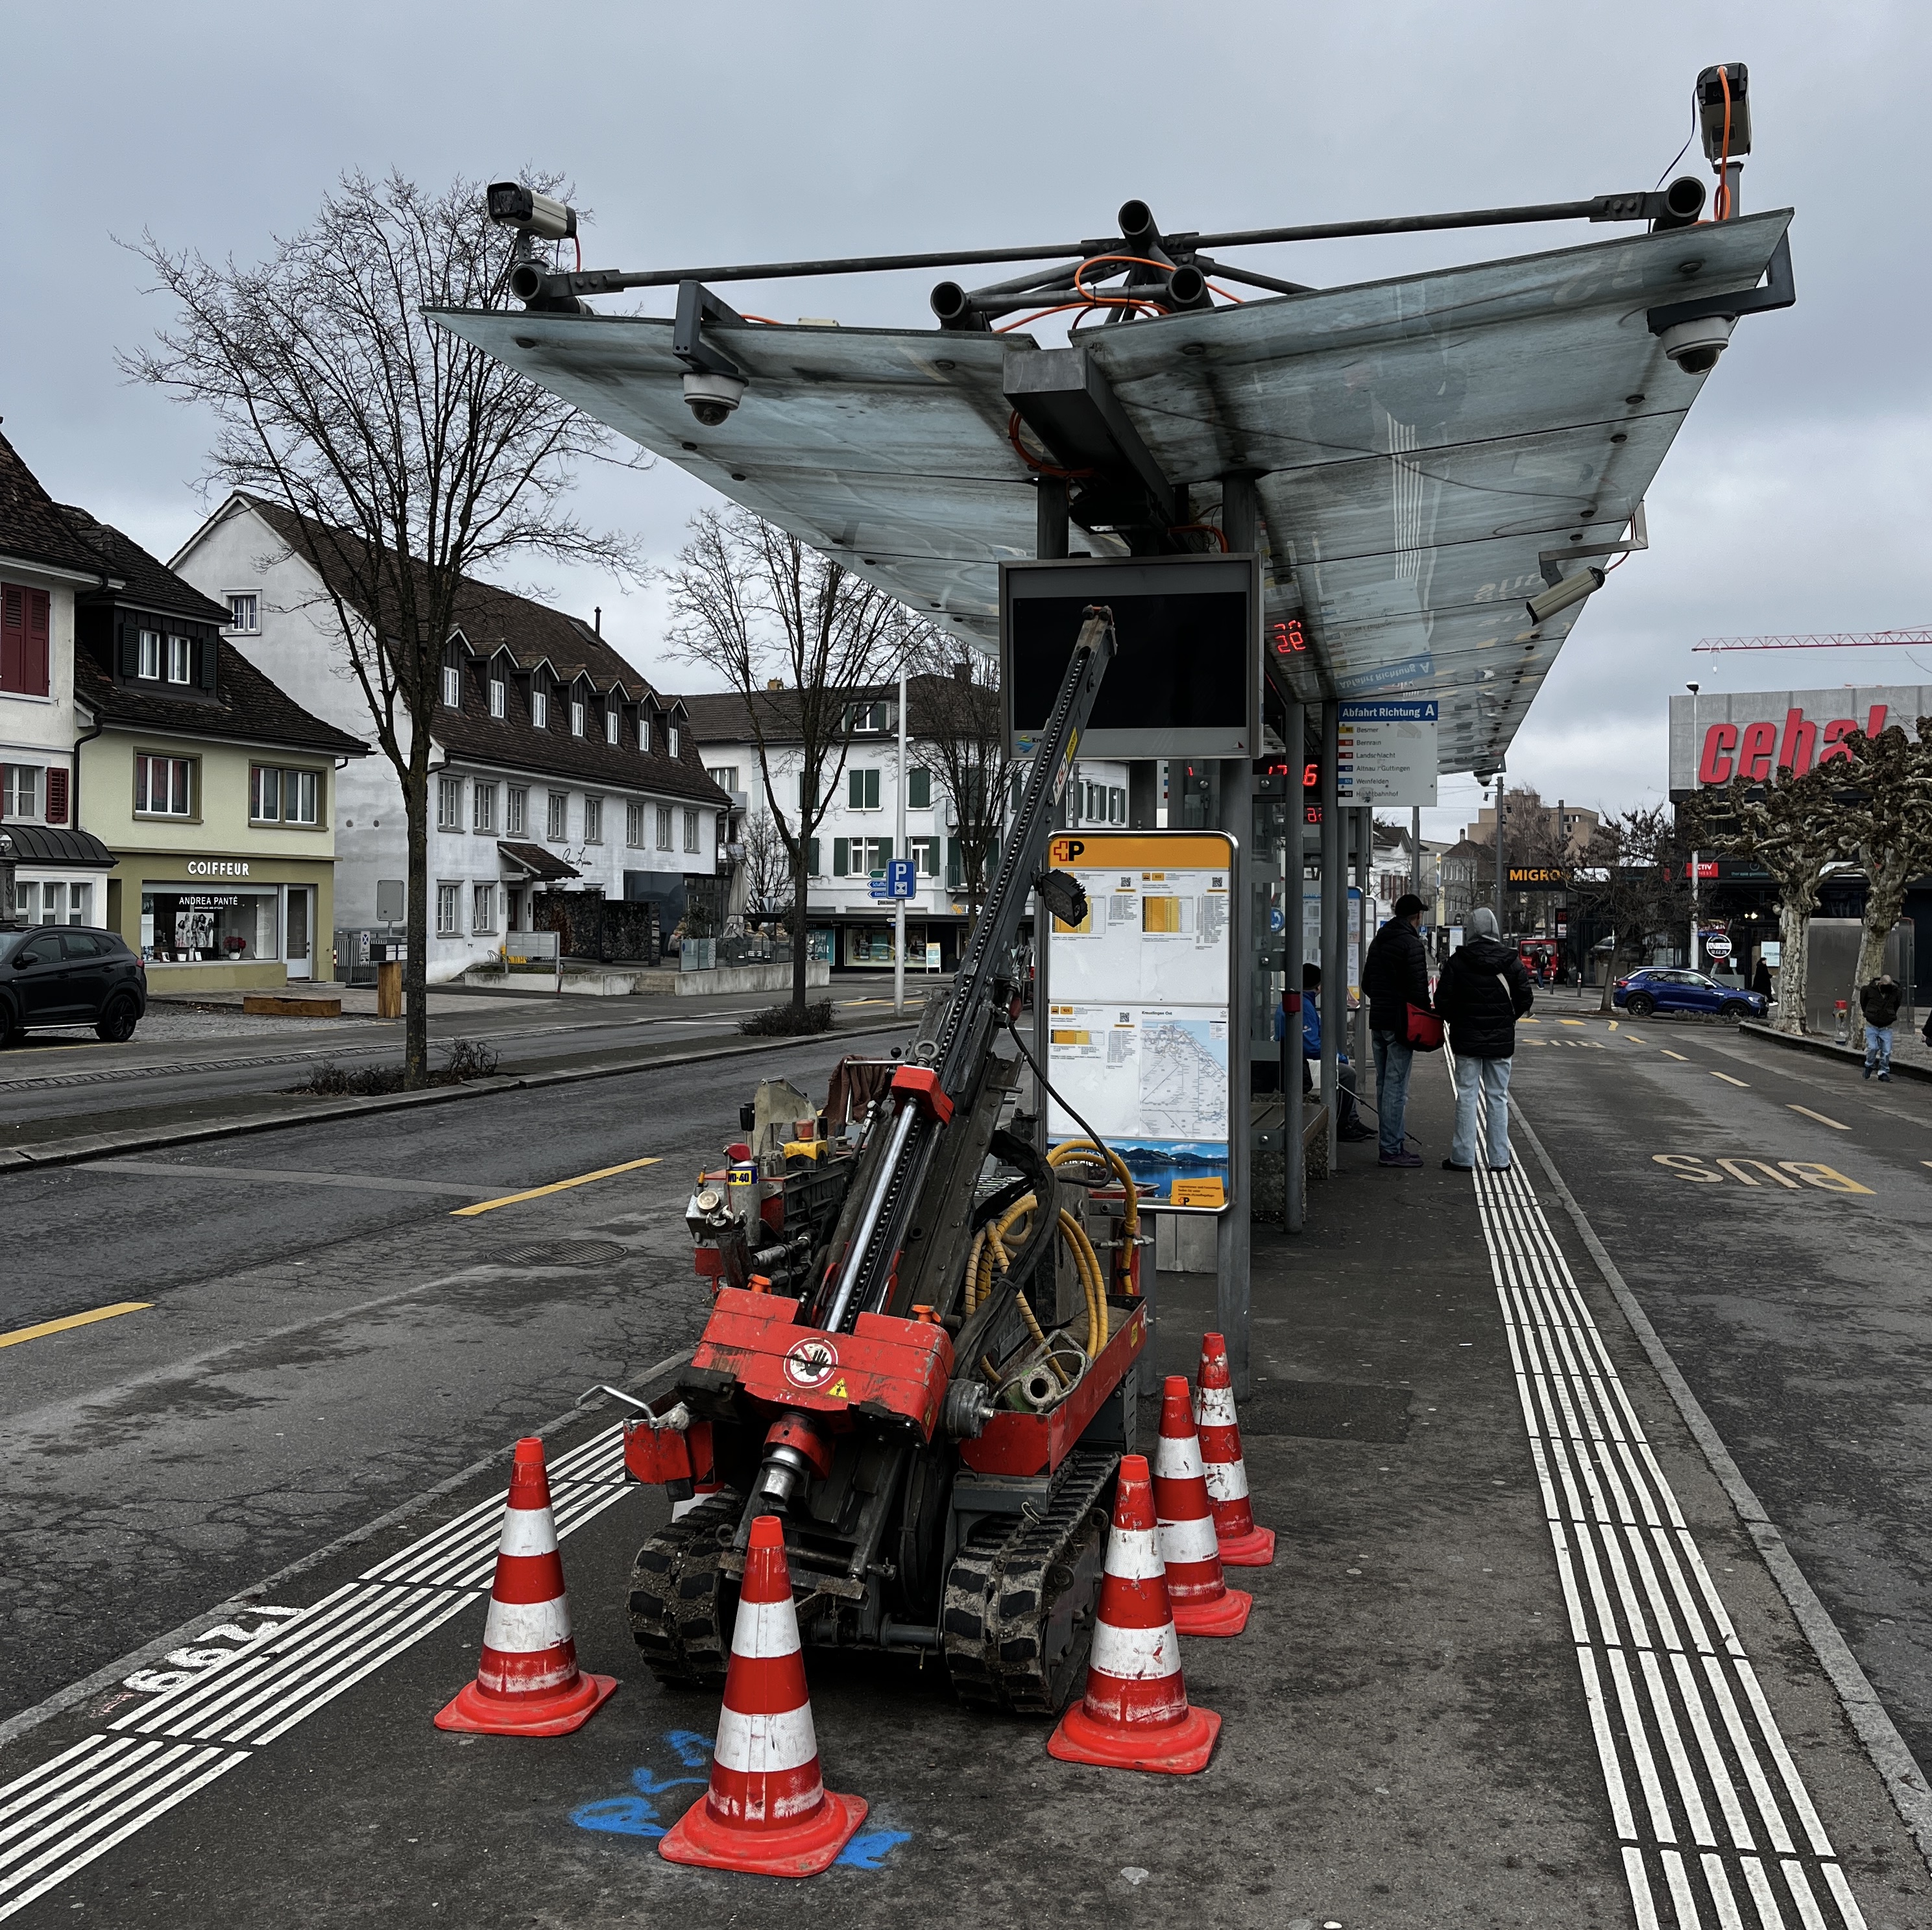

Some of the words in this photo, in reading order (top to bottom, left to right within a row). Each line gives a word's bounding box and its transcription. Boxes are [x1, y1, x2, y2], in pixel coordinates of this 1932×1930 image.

[1342, 708, 1377, 717] Abfahrt
[1379, 707, 1420, 718] Richtung
[1425, 704, 1434, 716] A
[187, 860, 249, 876] COIFFEUR
[895, 863, 907, 881] P
[178, 897, 211, 905] ANDREA
[213, 895, 238, 906] PANTÉ
[1521, 1039, 1606, 1048] BUS
[1652, 1154, 1878, 1194] BUS
